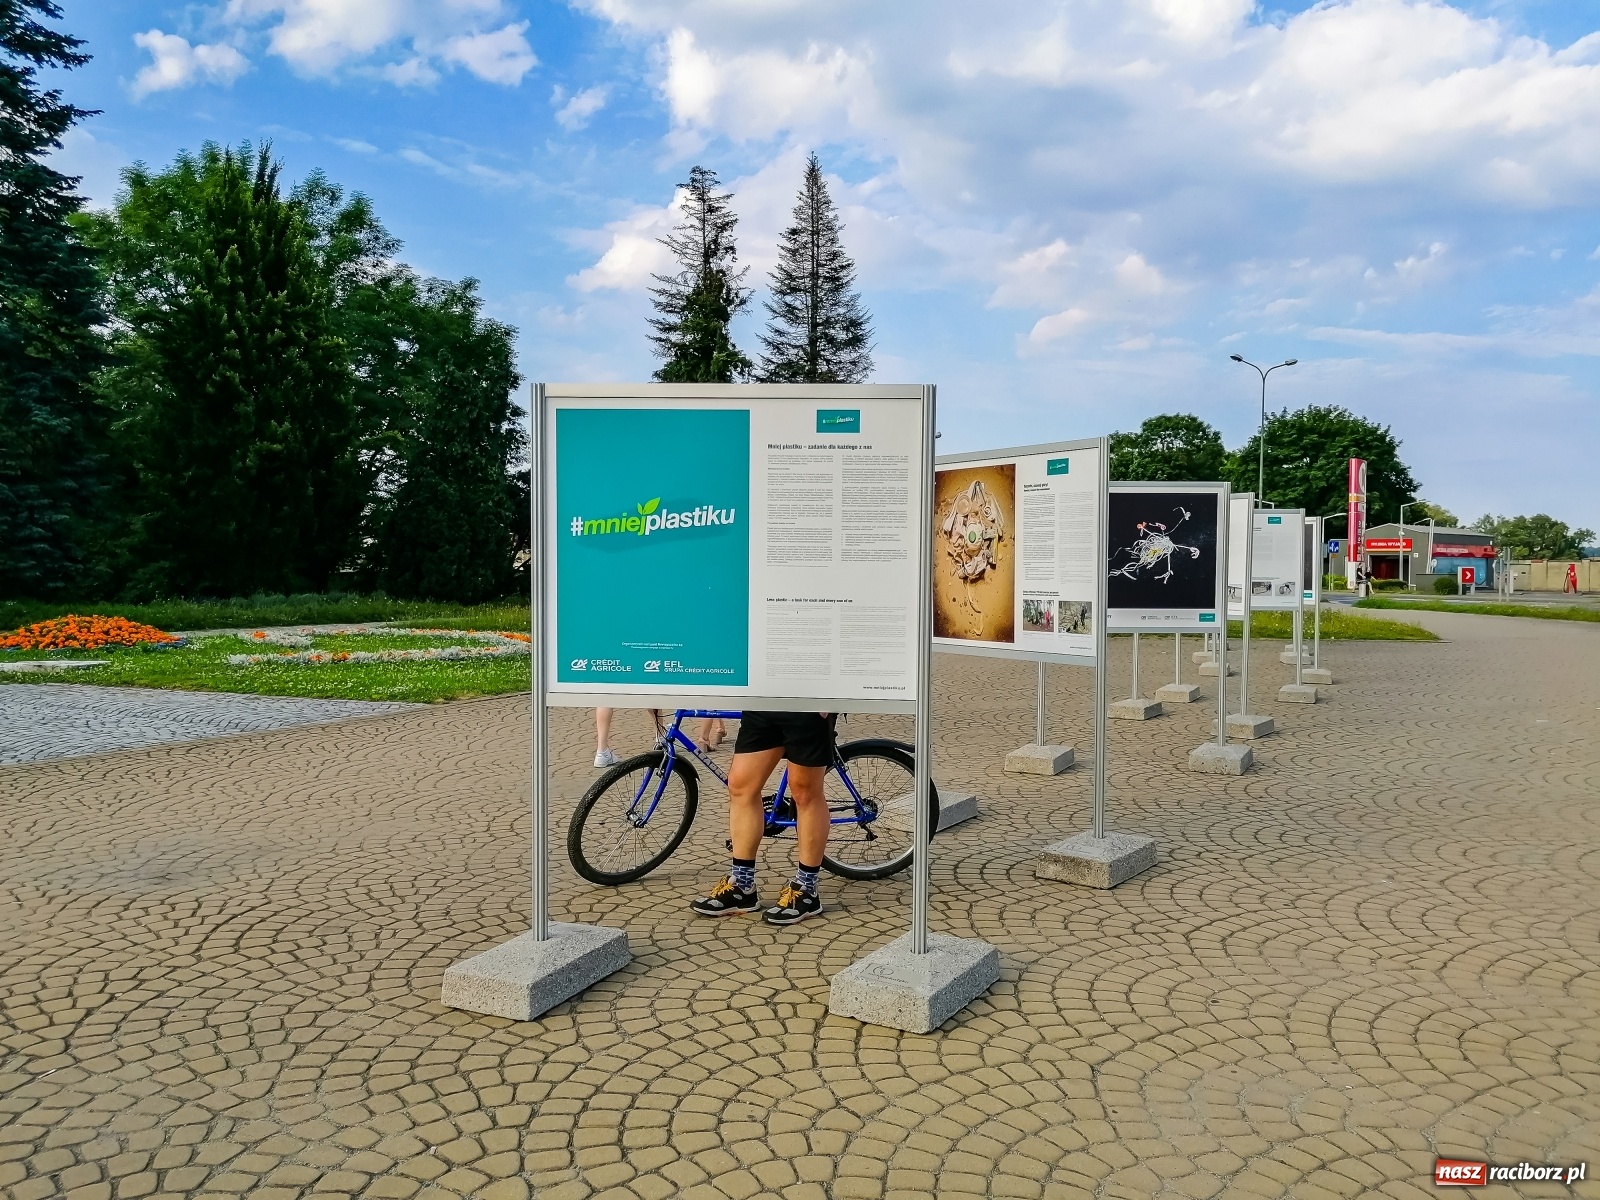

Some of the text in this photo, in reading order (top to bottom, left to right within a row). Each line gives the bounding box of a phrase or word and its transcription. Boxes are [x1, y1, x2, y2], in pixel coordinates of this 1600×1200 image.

[767, 443, 782, 451] Mniej
[782, 443, 803, 451] plastiku
[570, 505, 736, 537] #mniejplastiku
[590, 658, 621, 666] CRÉDIT
[664, 660, 684, 668] EFL
